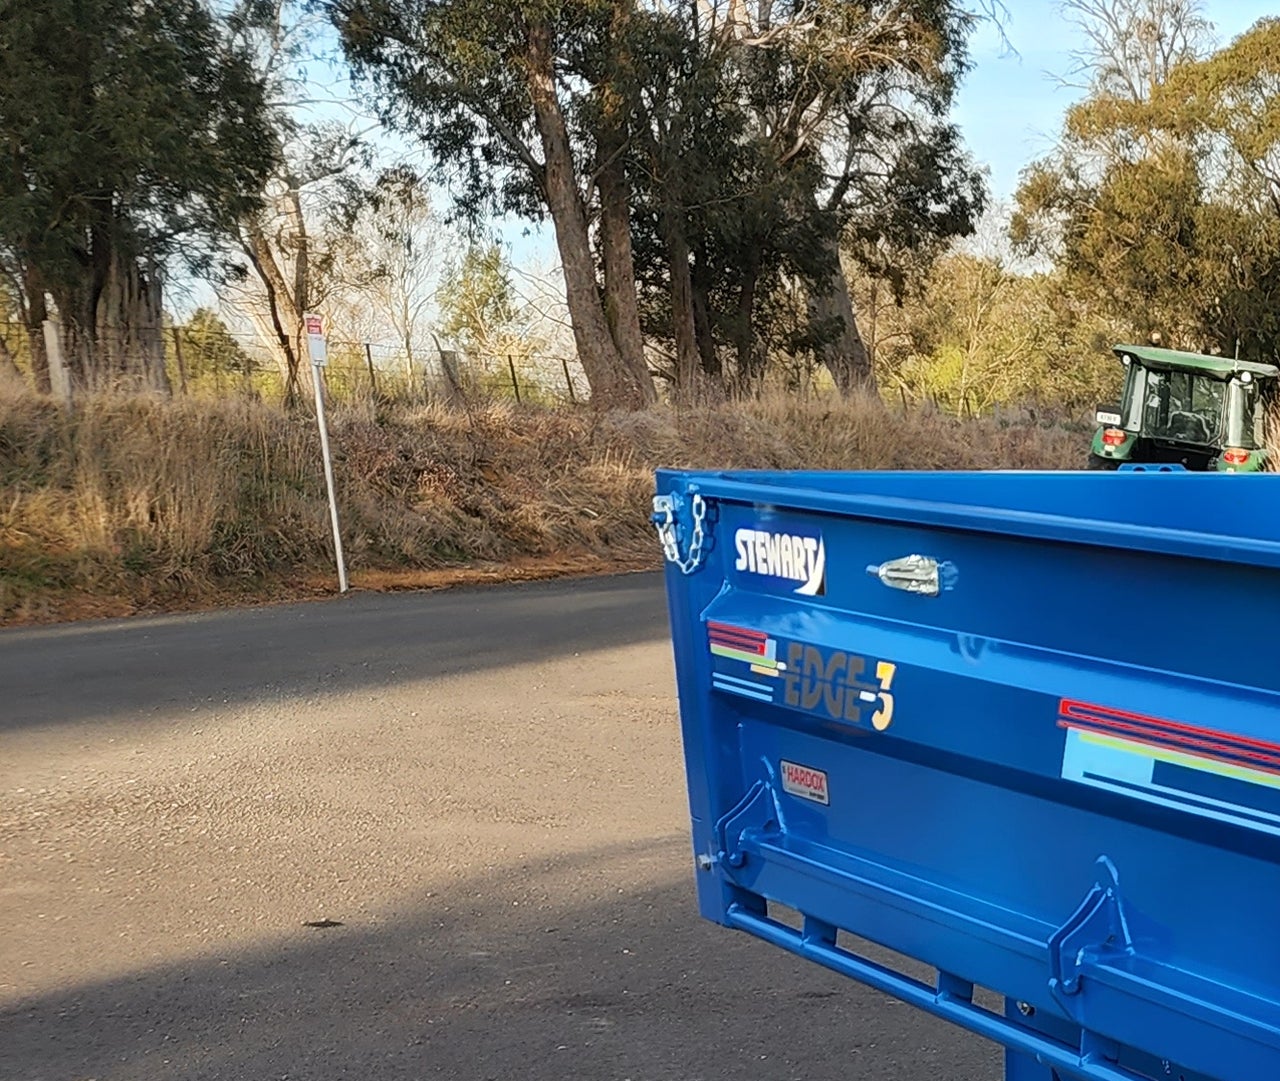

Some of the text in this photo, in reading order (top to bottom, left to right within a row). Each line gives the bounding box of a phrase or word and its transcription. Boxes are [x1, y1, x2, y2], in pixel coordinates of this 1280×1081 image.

[735, 528, 826, 596] STEWART
[783, 642, 897, 731] EDGE-3
[787, 765, 825, 792] HARDOX
